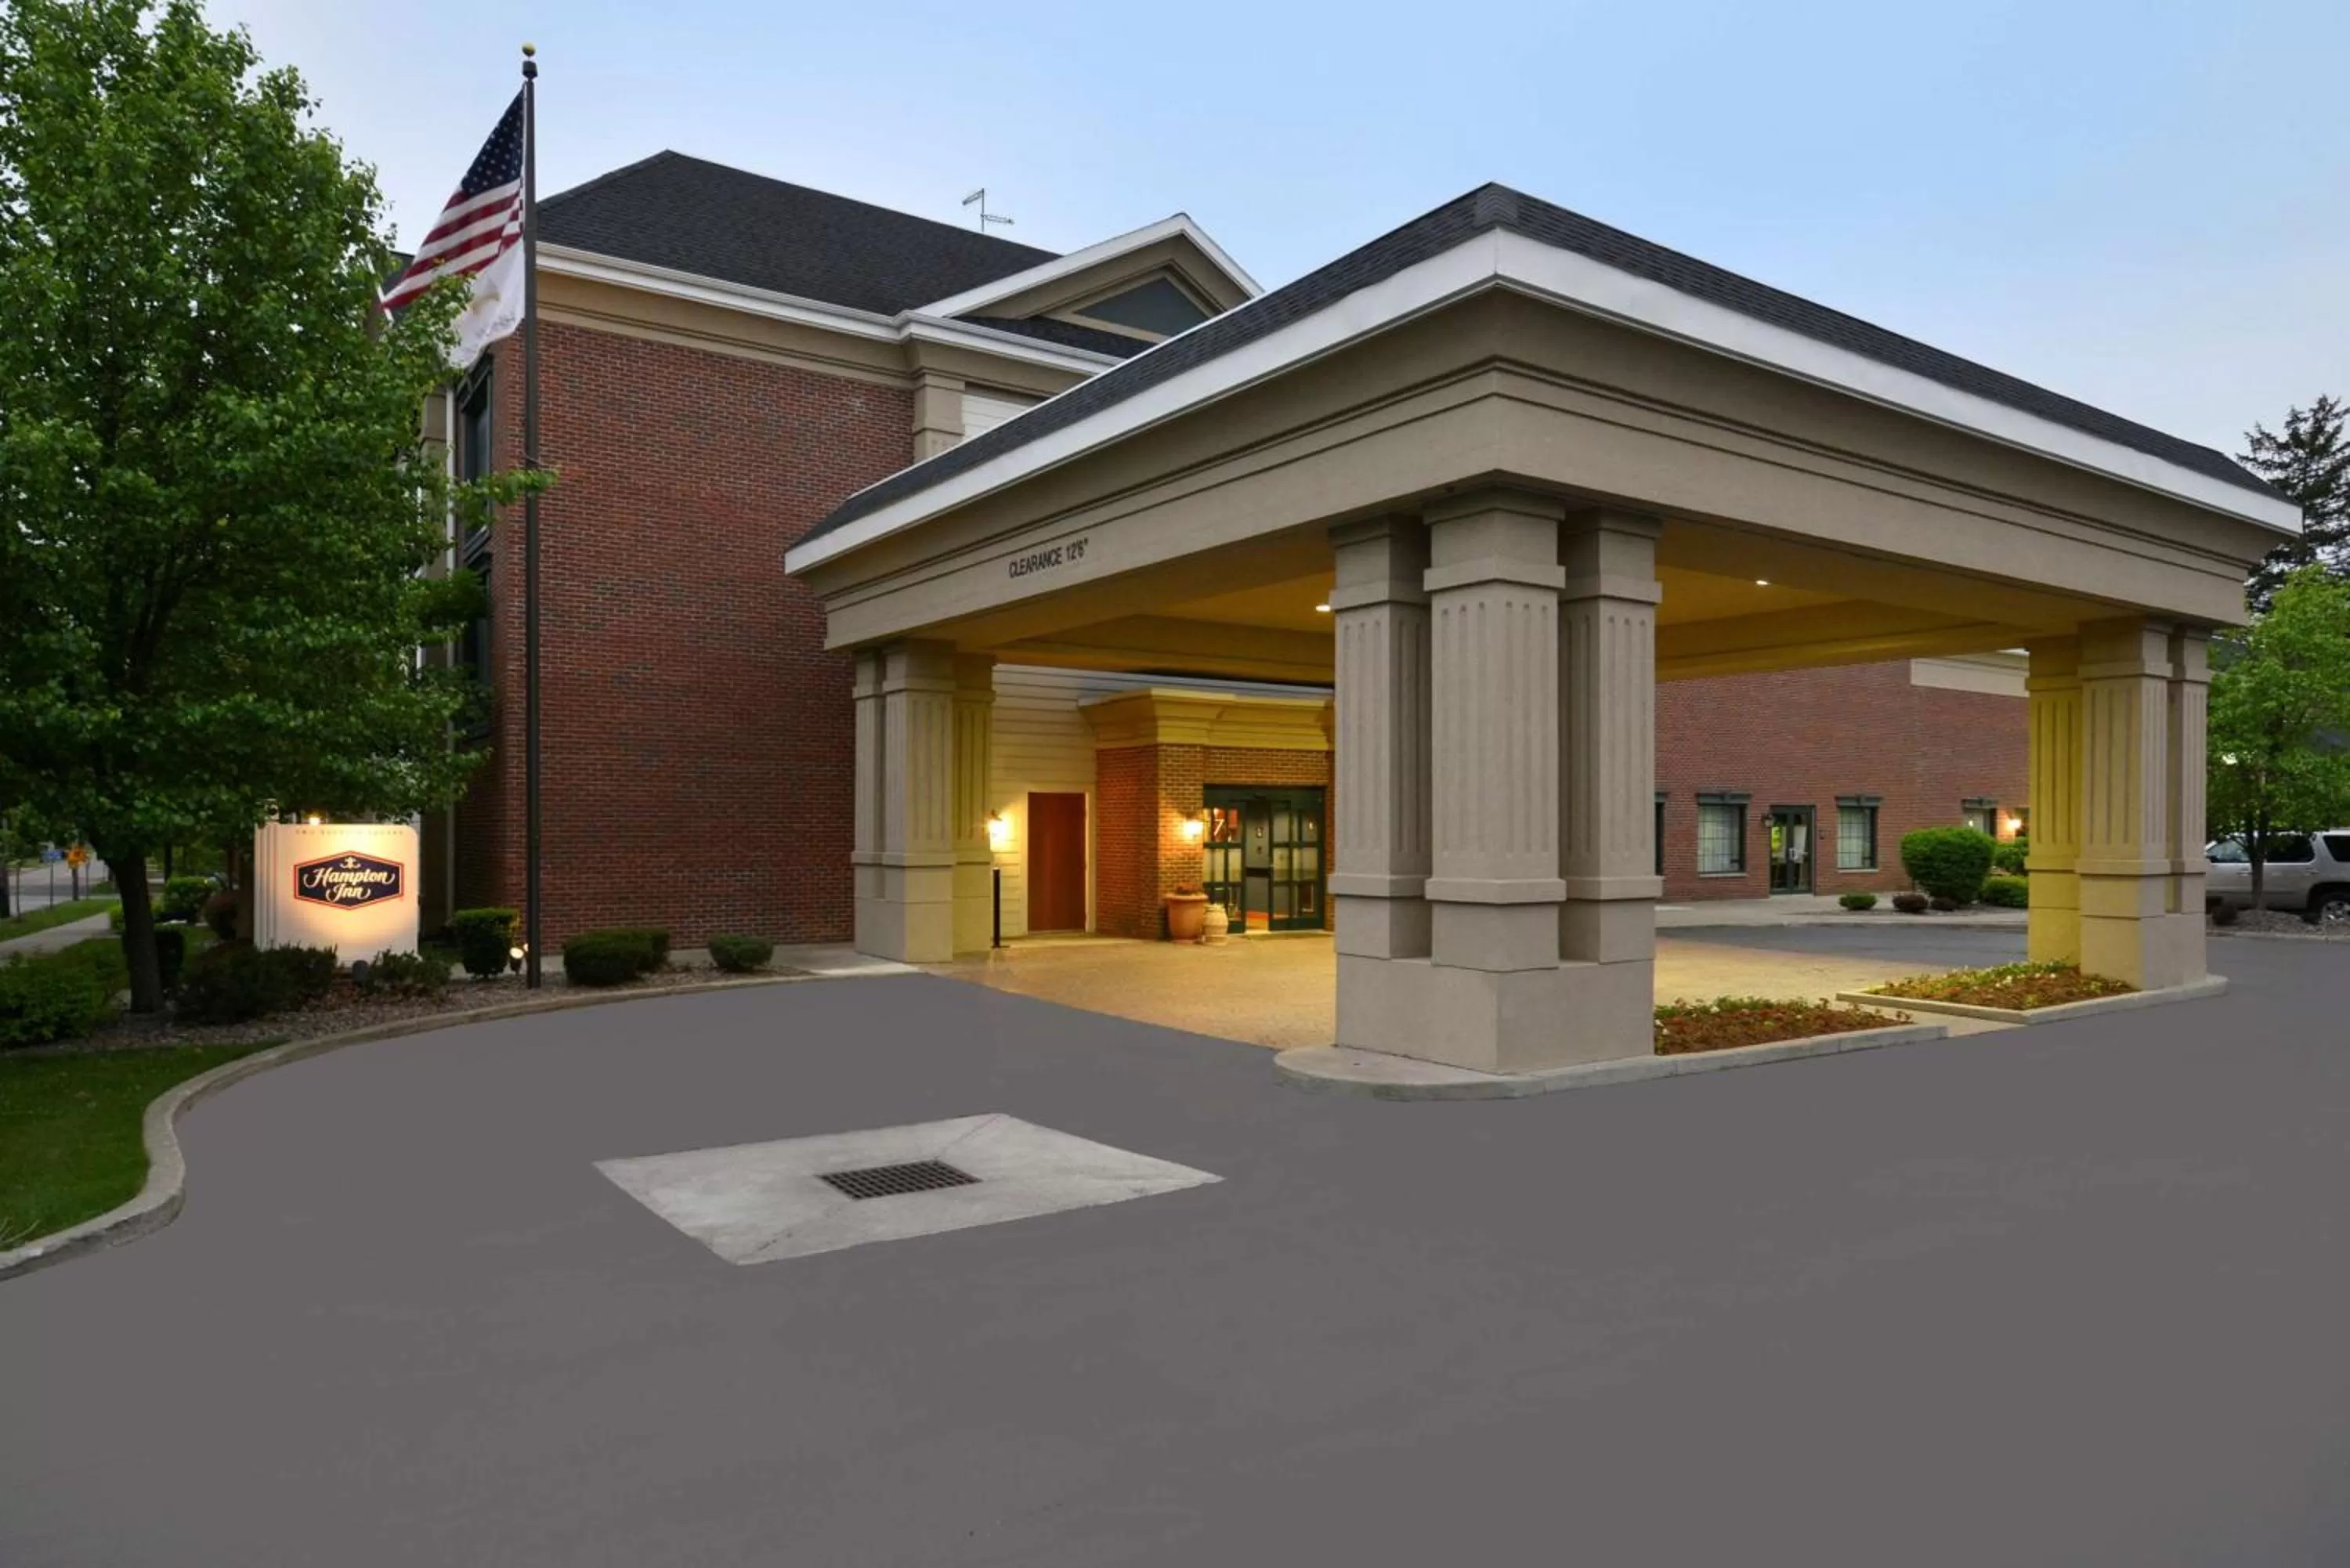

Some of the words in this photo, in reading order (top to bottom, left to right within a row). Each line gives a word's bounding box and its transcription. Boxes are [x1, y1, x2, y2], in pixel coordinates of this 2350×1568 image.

[1008, 547, 1062, 579] CLEARANCE
[303, 867, 395, 888] Hampton
[325, 883, 371, 902] Inn
